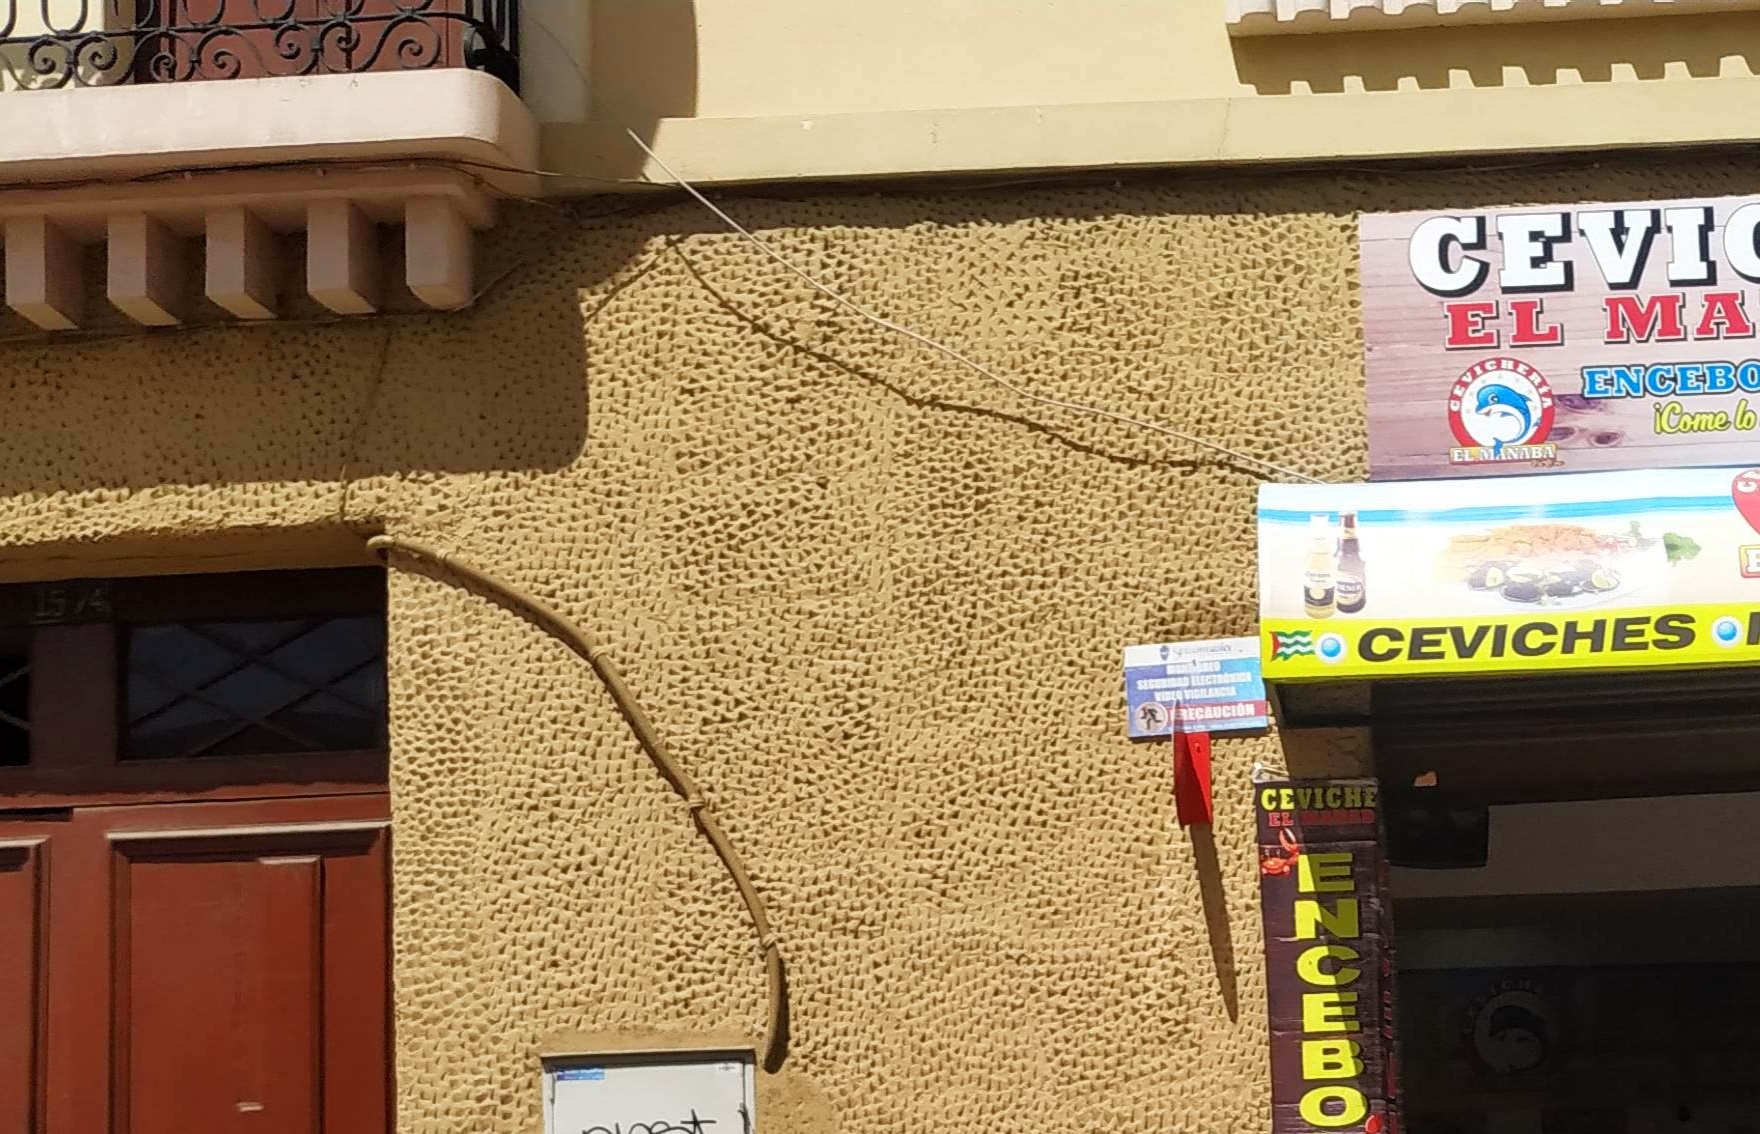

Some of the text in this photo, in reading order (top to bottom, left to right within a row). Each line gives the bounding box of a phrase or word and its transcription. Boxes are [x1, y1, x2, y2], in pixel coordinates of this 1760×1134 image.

[1443, 298, 1565, 350] EL
[1735, 398, 1756, 432] lo
[1356, 613, 1697, 663] CEVICHES
[1268, 811, 1295, 828] EL
